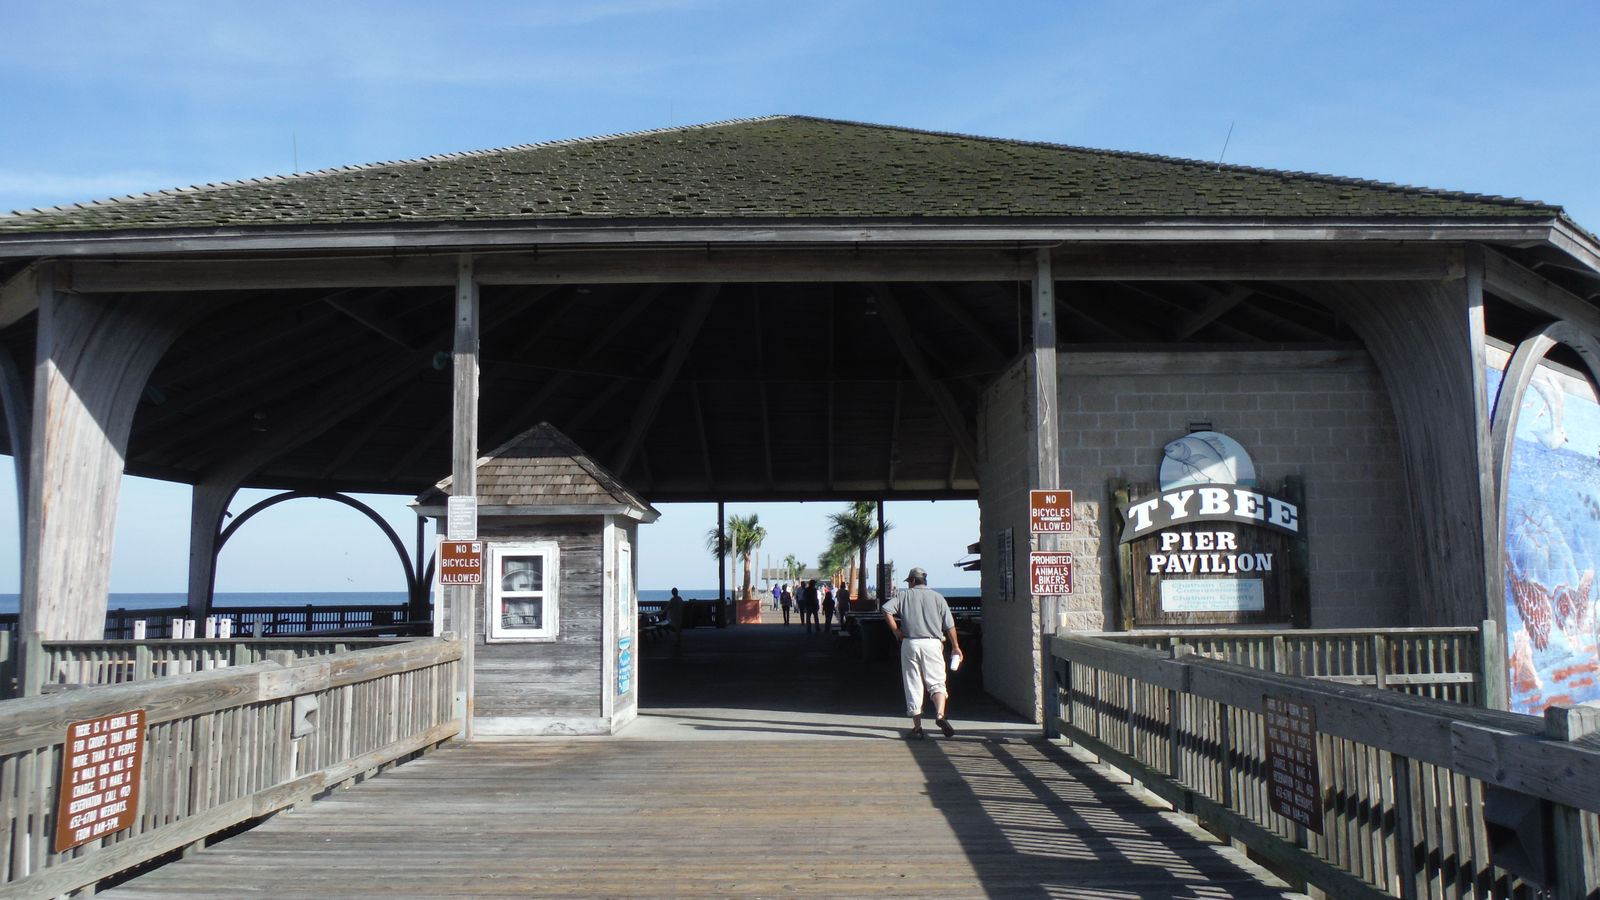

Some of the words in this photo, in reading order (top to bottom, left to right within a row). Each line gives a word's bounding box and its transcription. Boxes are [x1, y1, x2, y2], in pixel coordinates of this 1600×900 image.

[1045, 495, 1057, 504] NO
[1032, 508, 1071, 517] BICYCLES
[1128, 488, 1298, 532] TYBEE
[1033, 522, 1071, 531] ALLOWED
[1161, 531, 1237, 551] PIER
[455, 544, 467, 554] NO
[442, 558, 480, 568] BICYCLES
[1031, 555, 1072, 565] PROHIBITED
[1150, 553, 1273, 573] PAVILION
[1035, 567, 1069, 576] ANIMALS
[442, 573, 480, 582] ALLOWED
[1038, 575, 1066, 584] BIKERS
[1034, 584, 1070, 593] SKATERS
[75, 723, 91, 737] THERE
[94, 722, 100, 733] IS
[130, 713, 139, 725] FEE
[73, 739, 85, 753] FOR
[88, 735, 107, 750] GROUPS
[111, 731, 123, 744] THAT
[126, 727, 138, 740] HAVE
[72, 754, 88, 768] MORE
[92, 750, 106, 763] THAN
[109, 747, 115, 759] 12
[118, 742, 137, 756] PEOPLE
[127, 756, 135, 768] BE
[100, 778, 107, 790] TO
[109, 773, 124, 787] MAKE
[126, 771, 131, 782] A
[69, 794, 102, 814] RESERVATION
[105, 790, 117, 803] CALL
[75, 826, 91, 842] FROM
